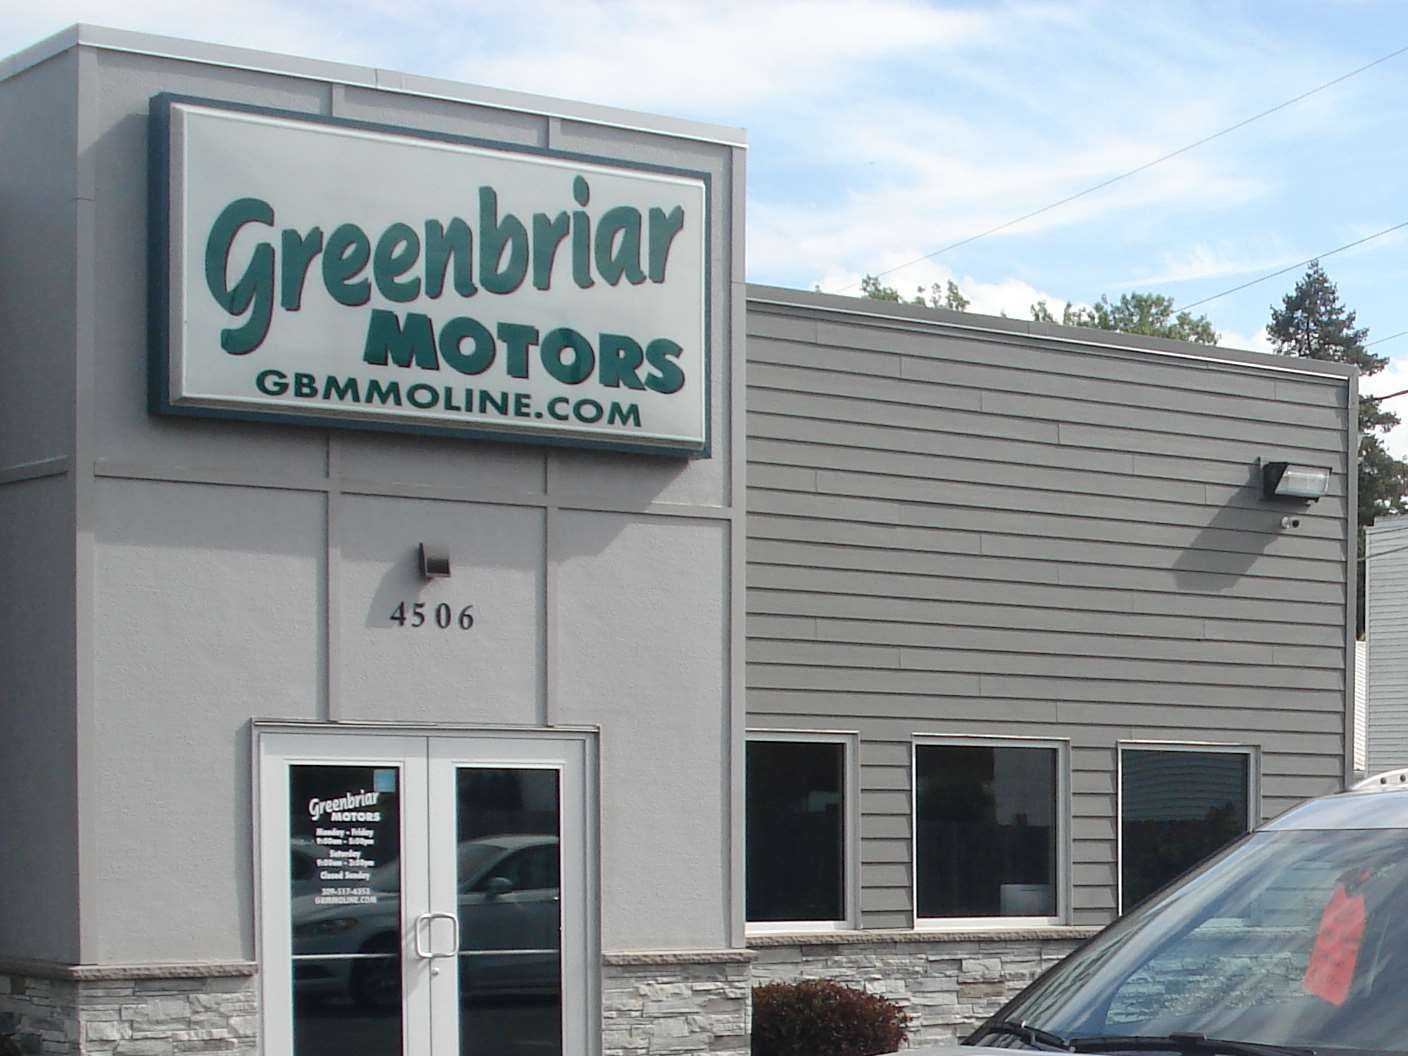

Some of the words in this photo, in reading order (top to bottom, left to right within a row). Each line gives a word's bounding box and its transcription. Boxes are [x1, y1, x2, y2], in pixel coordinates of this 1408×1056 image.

[205, 174, 684, 355] Greenbriar
[363, 308, 686, 394] MOTORS
[256, 369, 642, 428] GBMMOLINE.COM
[390, 601, 474, 630] 4506
[309, 789, 380, 820] Greenbriar
[331, 812, 381, 822] MOTORS
[316, 828, 345, 838] Monday
[351, 828, 374, 838] Friday
[330, 849, 361, 859] Saturday
[320, 871, 343, 879] Closed
[345, 871, 370, 880] Sunday
